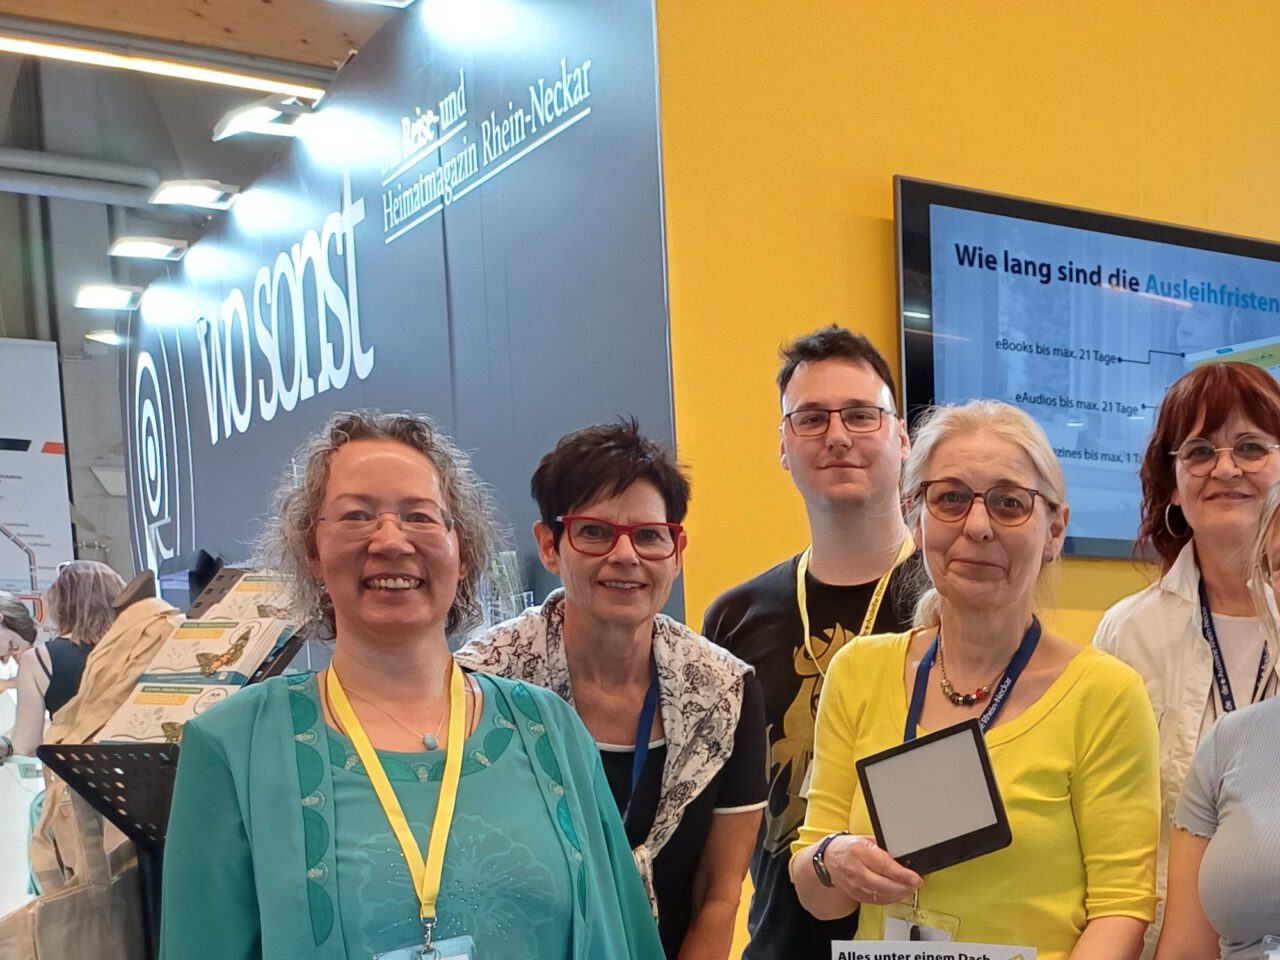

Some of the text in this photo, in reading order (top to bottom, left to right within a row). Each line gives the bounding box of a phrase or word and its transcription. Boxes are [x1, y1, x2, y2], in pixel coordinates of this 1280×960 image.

[382, 57, 591, 232] Heimatmagazin Rhein-Neckar
[954, 243, 997, 271] Wie
[1004, 250, 1051, 284] lang
[1057, 261, 1102, 287] sind
[1108, 268, 1141, 292] die
[254, 165, 374, 422] sonst
[995, 338, 1118, 365] eBooks bis max. 21 Tage
[1015, 392, 1139, 417] eAudios bis max. 21 Tage
[1084, 449, 1098, 461] bis
[1101, 452, 1124, 463] max.
